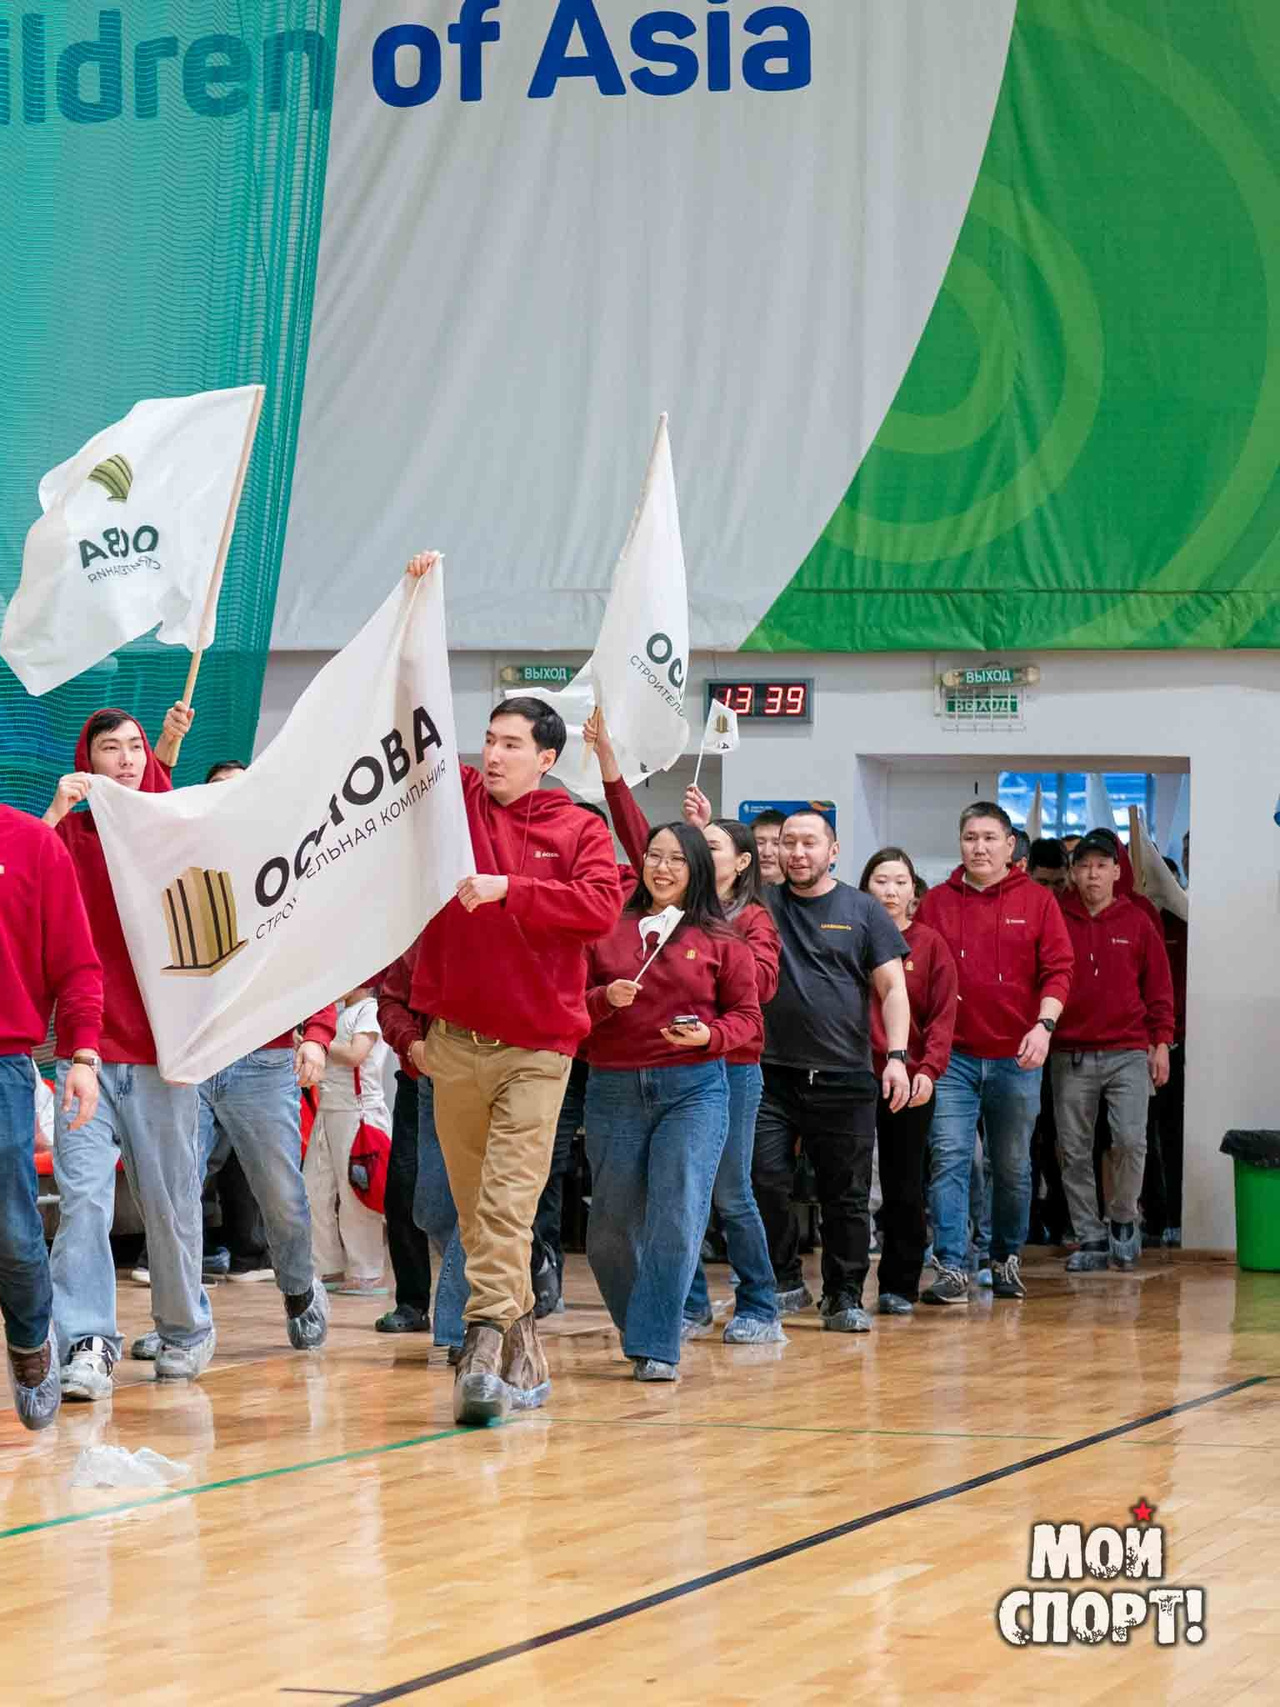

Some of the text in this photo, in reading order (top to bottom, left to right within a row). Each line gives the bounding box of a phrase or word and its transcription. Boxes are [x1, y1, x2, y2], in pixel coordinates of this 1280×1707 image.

[372, 0, 500, 108] of
[526, 0, 812, 98] Asia
[524, 667, 567, 681] ВЫХОД
[966, 669, 1011, 684] ВЫХОД
[723, 687, 804, 714] 13 39
[379, 759, 447, 827] КОМПАНИЯ
